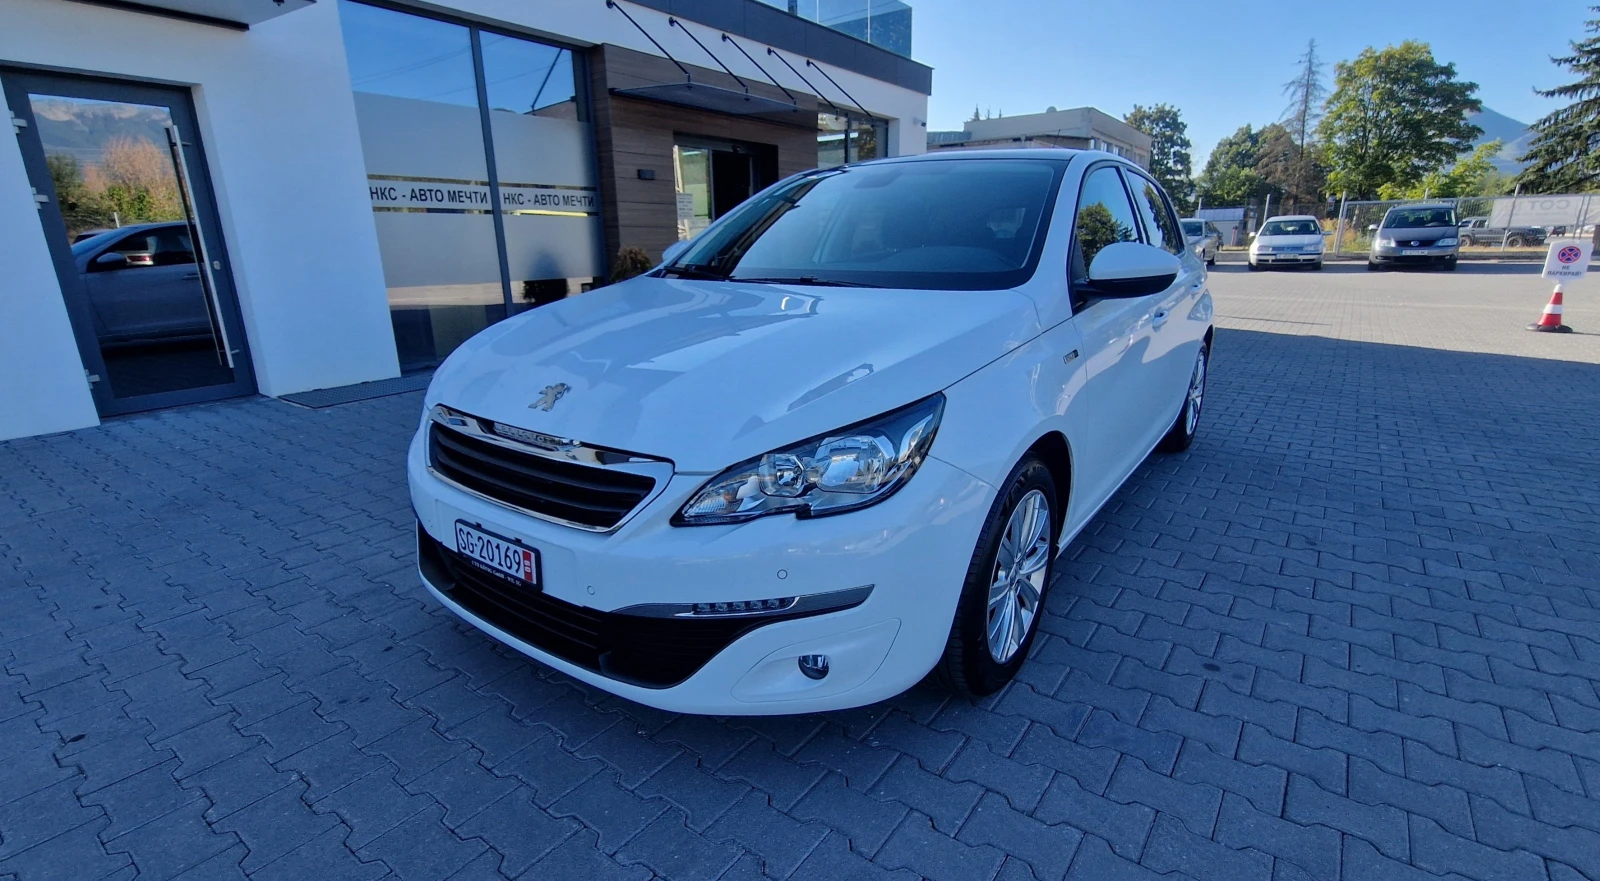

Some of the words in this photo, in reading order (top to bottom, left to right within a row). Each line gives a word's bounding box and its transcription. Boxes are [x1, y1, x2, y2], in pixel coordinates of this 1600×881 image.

[369, 186, 397, 201] НКС
[410, 188, 444, 203] АВТО
[449, 190, 488, 204] МЕЧТИ
[503, 192, 524, 206] НКС
[533, 193, 560, 207] АВТО
[562, 195, 594, 207] МЕЧТИ
